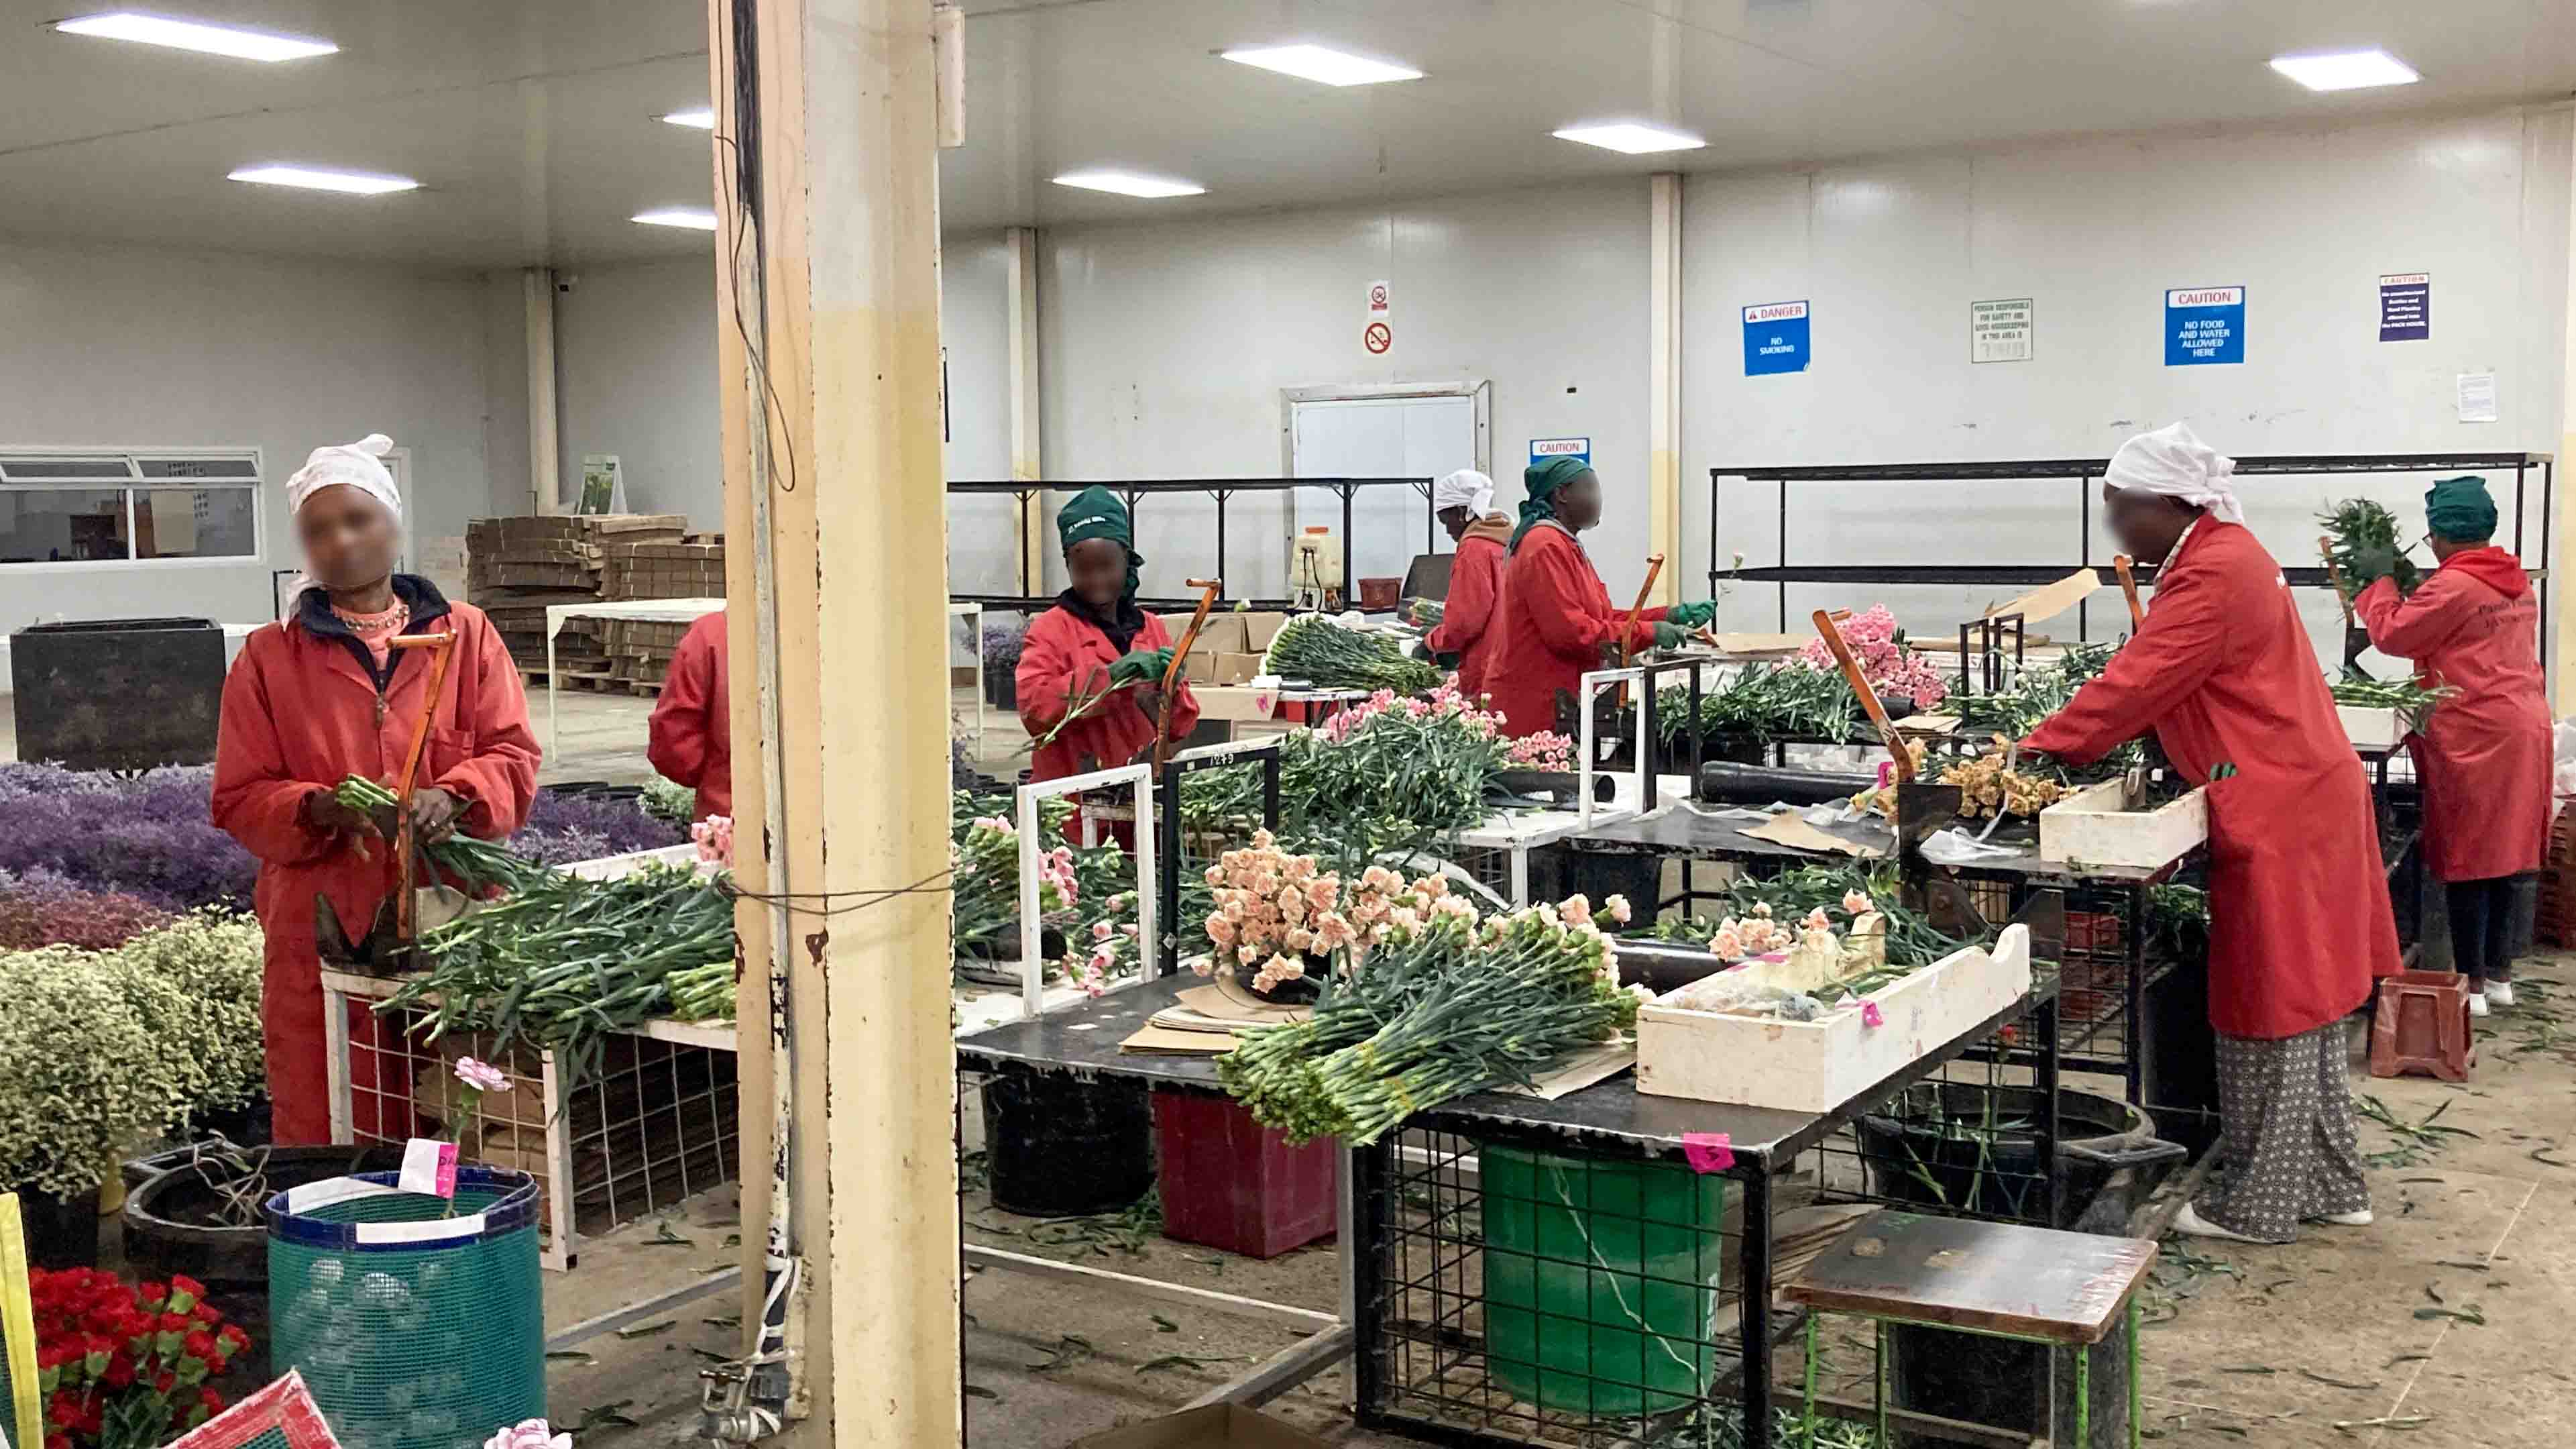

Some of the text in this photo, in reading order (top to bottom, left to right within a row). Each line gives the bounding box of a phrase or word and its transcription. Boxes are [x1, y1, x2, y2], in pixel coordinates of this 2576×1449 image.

[2178, 291, 2232, 304] CAUTION
[1760, 306, 1802, 318] DANGER
[2184, 320, 2225, 329] NO FOOD
[2178, 329, 2230, 339] AND WATER
[1771, 337, 1783, 345] NO
[2182, 339, 2224, 348] ALLOWED
[1759, 345, 1795, 355] SMOKING
[2192, 348, 2216, 358] HERE
[1540, 443, 1579, 452] CAUTION
